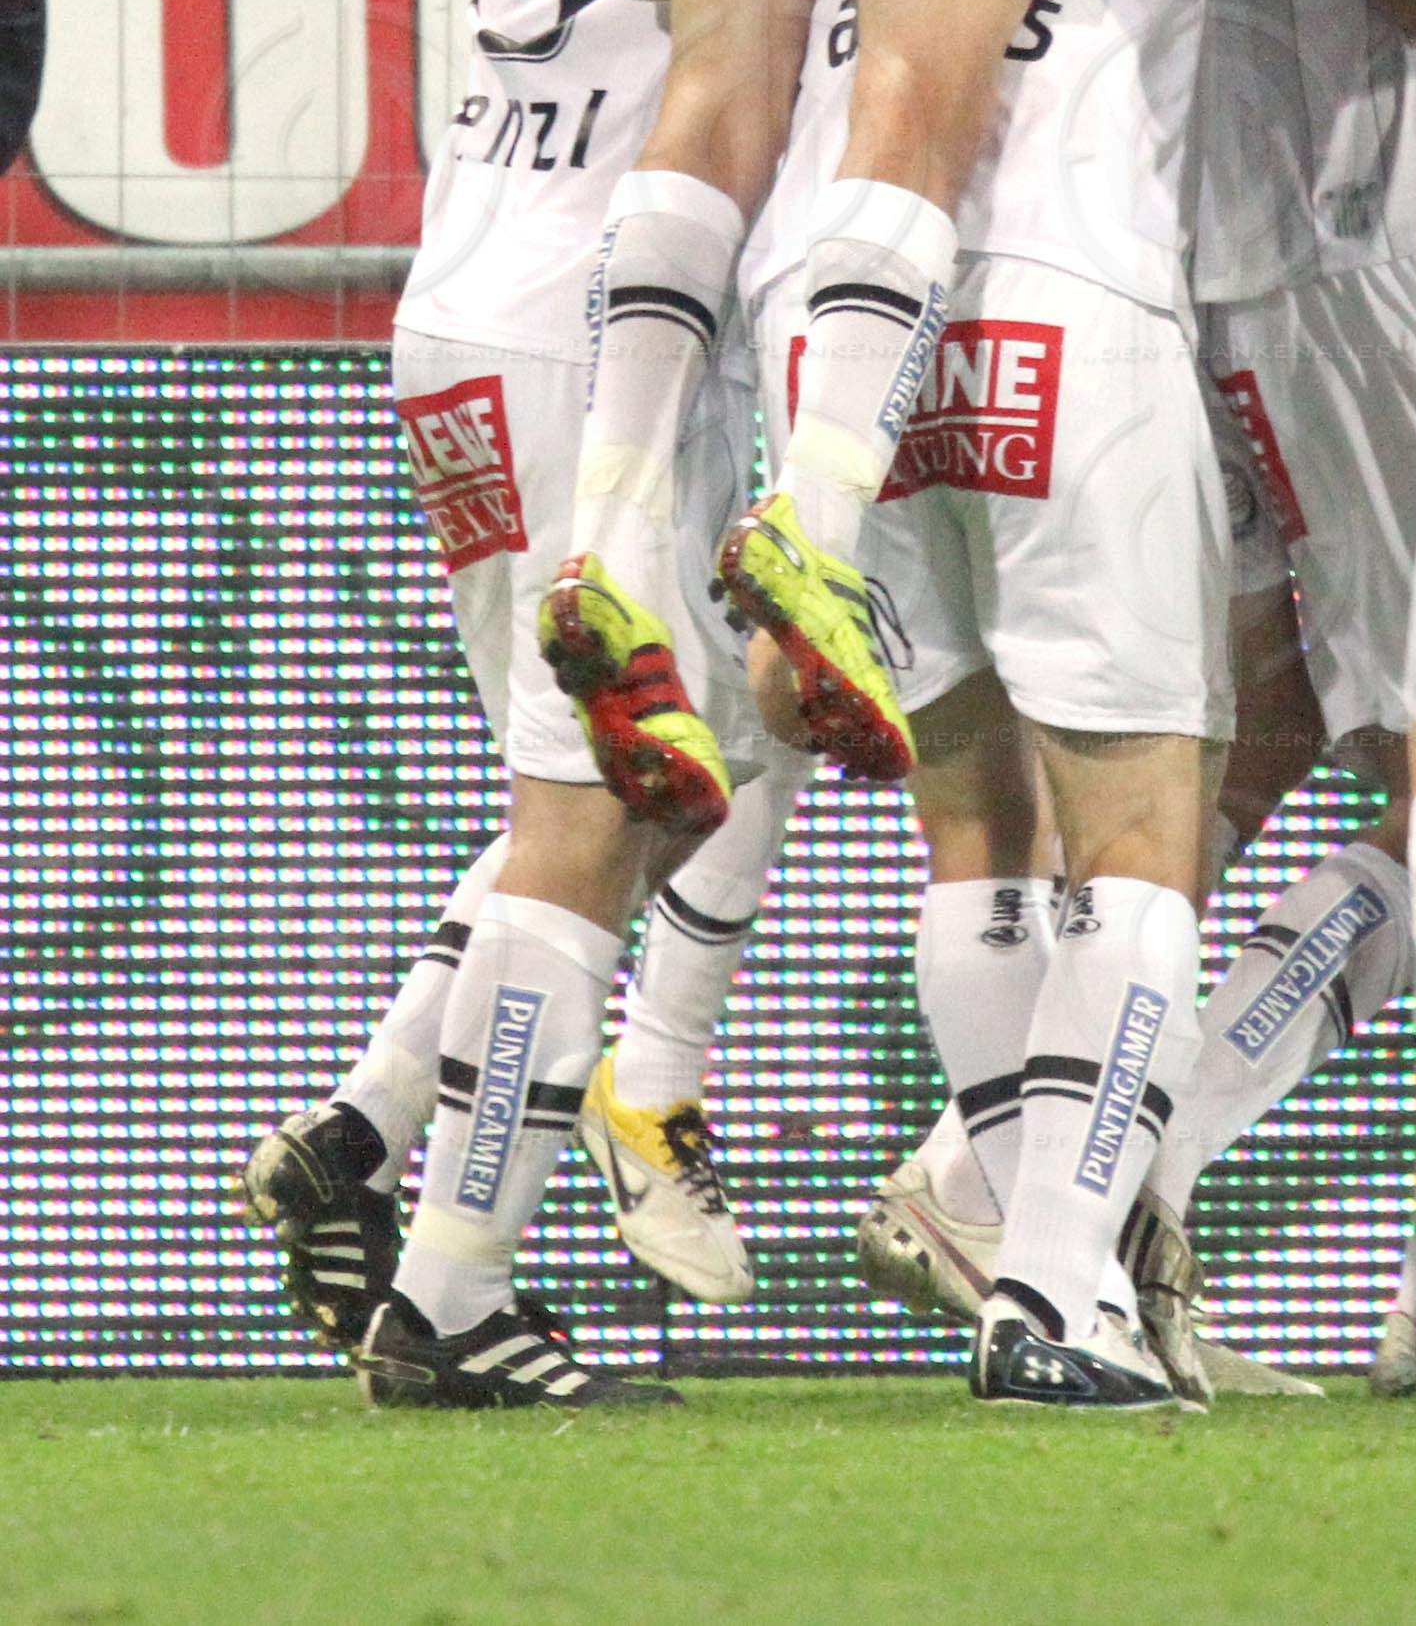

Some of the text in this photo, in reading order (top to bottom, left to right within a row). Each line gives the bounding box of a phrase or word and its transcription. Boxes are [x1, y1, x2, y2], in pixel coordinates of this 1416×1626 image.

[1243, 892, 1388, 1052] PUNTIGAMER
[457, 996, 536, 1204] PUNTIGAMER
[1081, 993, 1167, 1189] PUNTIGAMER
